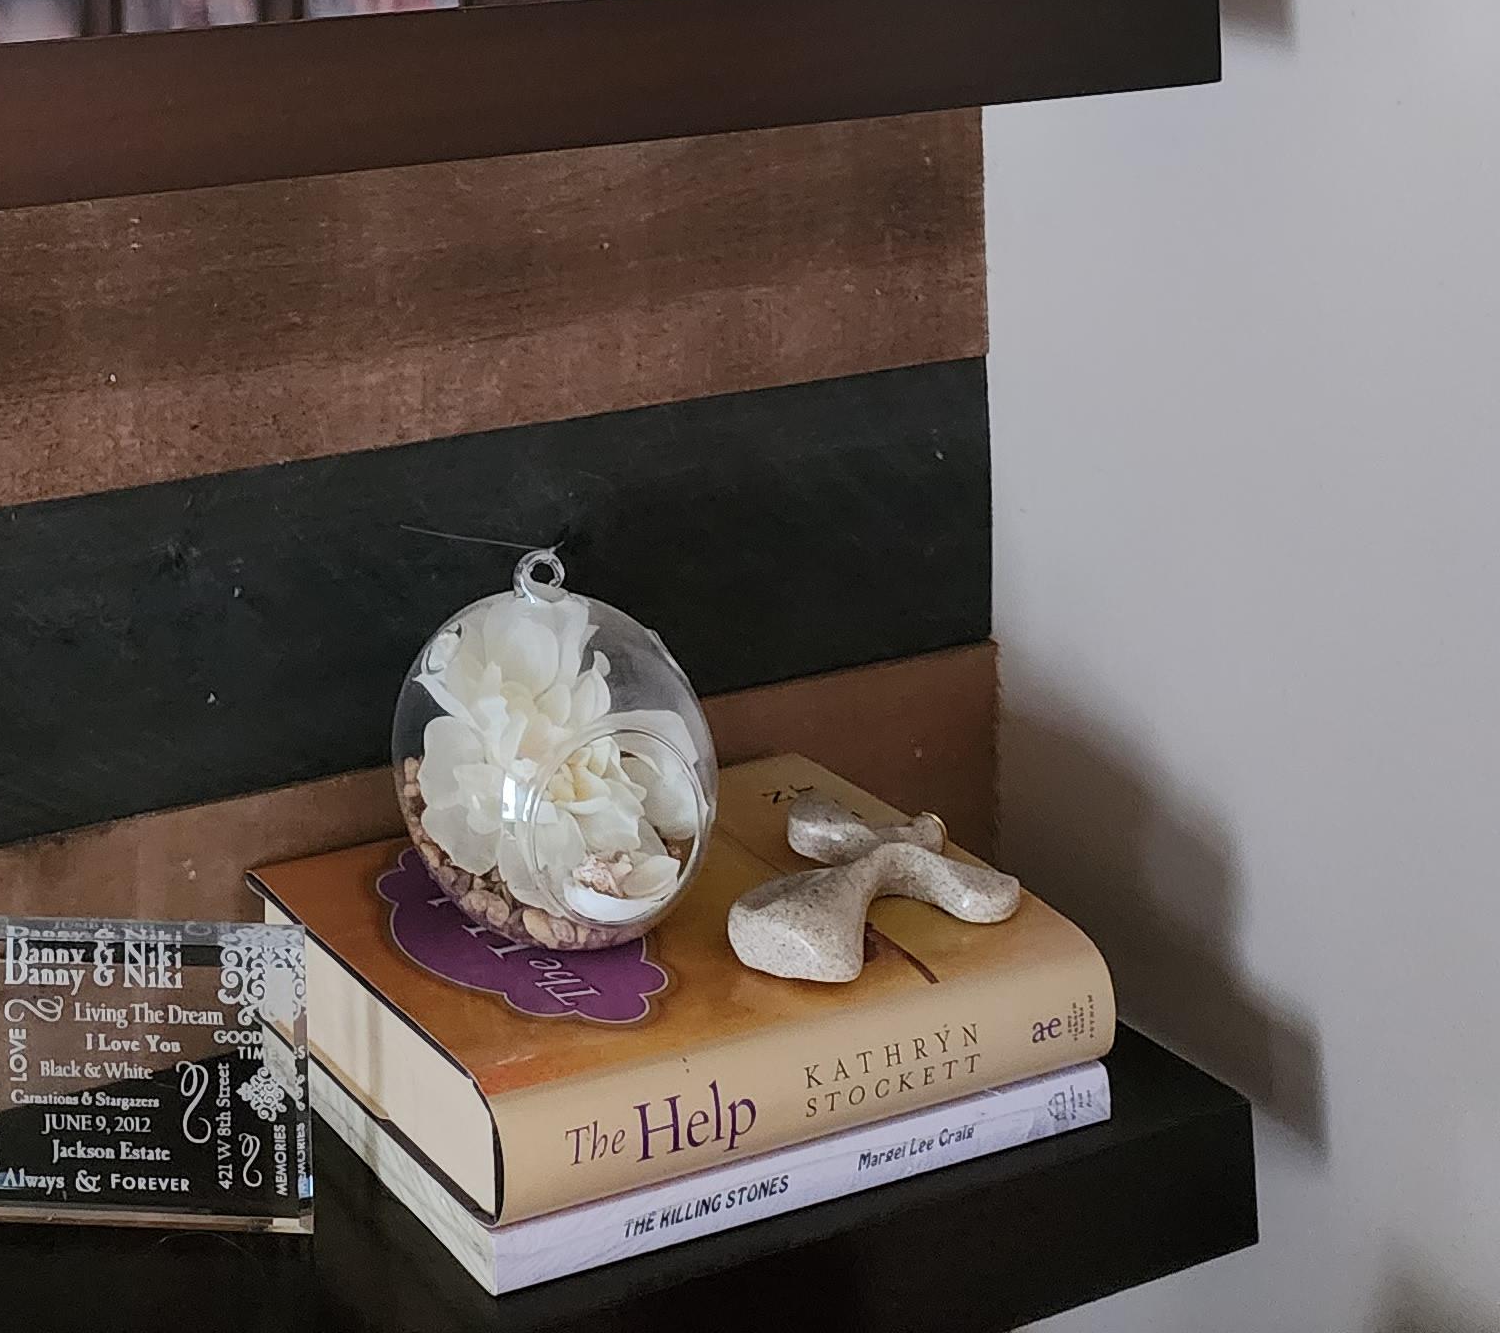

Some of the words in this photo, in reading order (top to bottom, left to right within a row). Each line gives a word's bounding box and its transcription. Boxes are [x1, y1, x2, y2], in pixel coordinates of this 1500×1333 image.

[4, 960, 85, 995] Danny
[123, 961, 183, 988] Niki
[74, 1002, 127, 1028] Living
[130, 1002, 164, 1024] The
[167, 1004, 224, 1026] Dream
[86, 1033, 93, 1051] I
[98, 1033, 140, 1052] Love
[145, 1034, 181, 1053] You
[213, 1029, 263, 1045] GOOD
[8, 1028, 28, 1082] LOVE
[804, 1023, 980, 1089] KATHRYN
[40, 1059, 81, 1078] Black
[84, 1062, 101, 1078] &
[104, 1061, 153, 1080] White
[216, 1062, 230, 1108] Street
[805, 1053, 982, 1119] STOCKETT
[10, 1089, 79, 1106] Carnations
[81, 1092, 93, 1106] &
[95, 1091, 160, 1111] Stargazers
[41, 1114, 92, 1135] JUNE
[95, 1116, 111, 1135] 9,
[114, 1116, 151, 1133] 2012
[215, 1110, 231, 1136] 8th
[565, 1119, 626, 1167] The
[633, 1079, 758, 1163] Help
[52, 1139, 115, 1164] Jackson
[119, 1141, 171, 1161] Estate
[217, 1140, 232, 1161] W
[908, 1132, 935, 1155] Lee
[273, 1124, 288, 1197] MEMORIES
[2, 1168, 65, 1195] Always
[75, 1169, 101, 1193] &
[110, 1173, 190, 1192] FOREVER
[218, 1162, 233, 1190] 421
[623, 1208, 656, 1239] THE
[658, 1193, 722, 1229] KILLING
[724, 1174, 790, 1208] STONES
